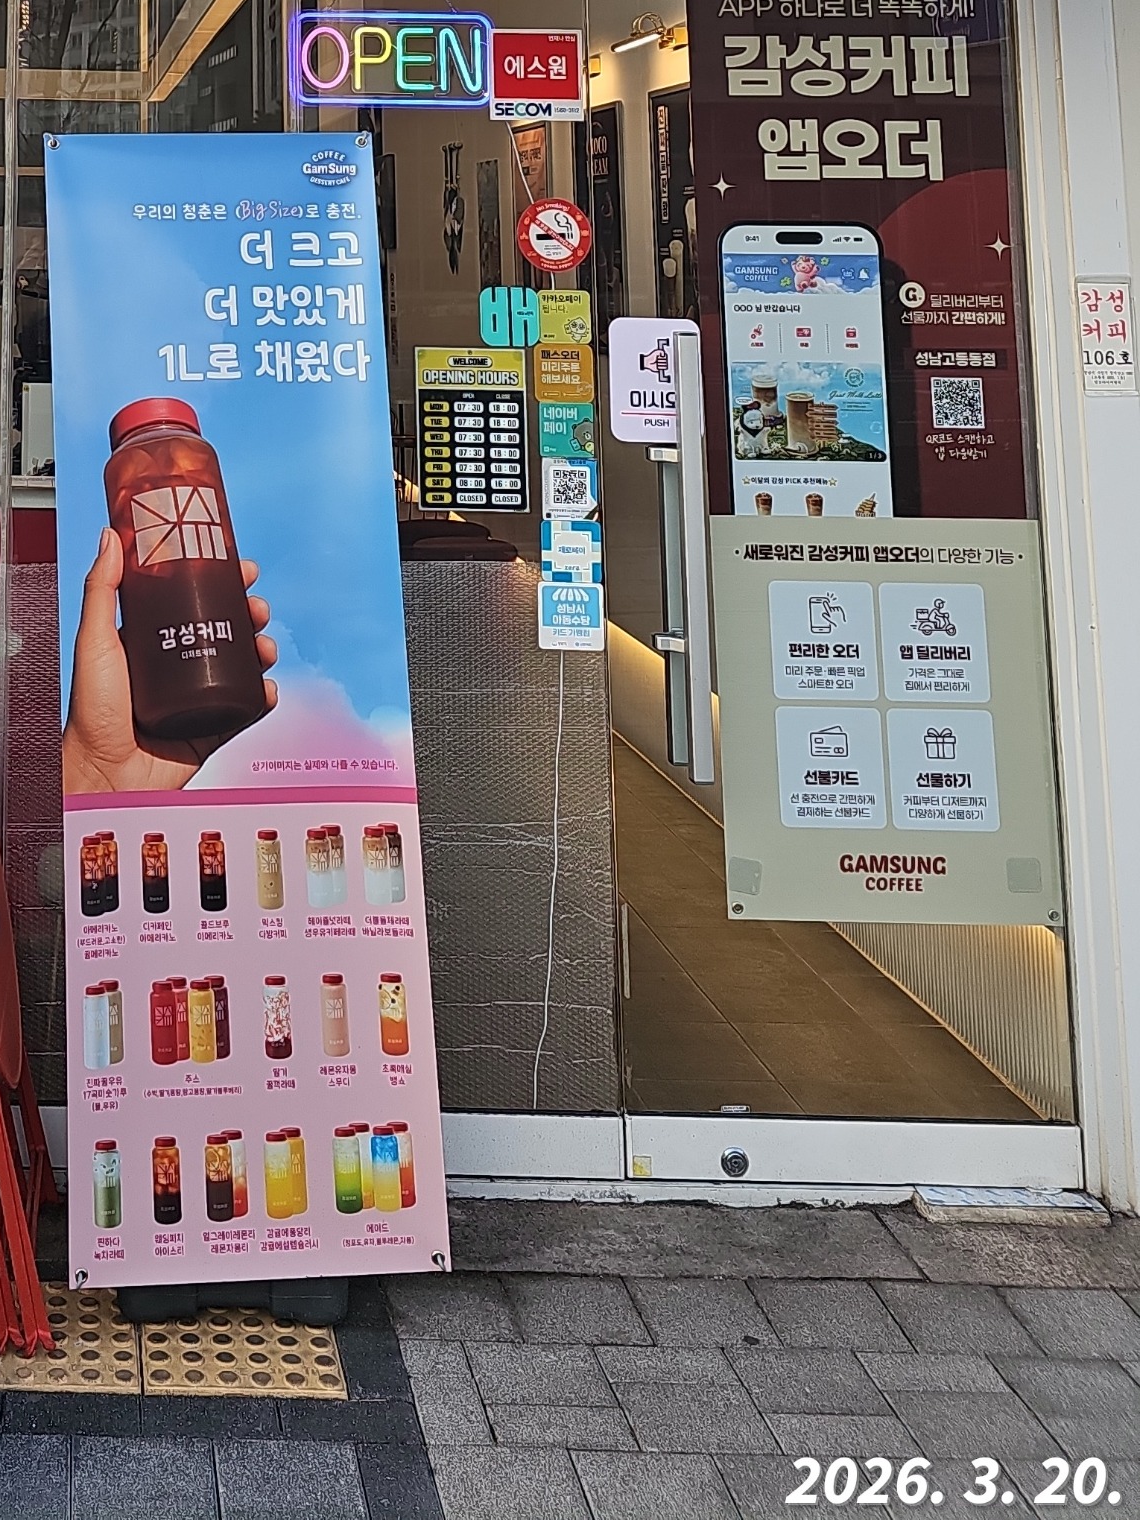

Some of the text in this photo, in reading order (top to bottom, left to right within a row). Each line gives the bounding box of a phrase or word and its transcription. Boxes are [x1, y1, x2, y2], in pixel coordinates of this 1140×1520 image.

[301, 25, 482, 92] OPEN
[503, 54, 568, 80] 에스원
[722, 33, 971, 98] 감성커피
[494, 101, 552, 117] SECOM
[311, 150, 346, 162] COFFEE
[757, 117, 945, 182] 앱오더
[302, 162, 357, 176] GamSung
[132, 202, 177, 221] 우리의
[182, 201, 228, 221] 청춘은
[326, 202, 362, 220] 충전.
[745, 235, 760, 243] 9:41
[239, 230, 364, 270] 더 크고
[734, 266, 779, 276] GAMSUNG
[204, 282, 367, 328] 더 맛있게
[541, 294, 581, 304] 카카오페이
[930, 294, 1004, 309] 딜리버리부터
[541, 304, 569, 314] 됩니다.
[763, 304, 801, 314] 반갑습니다
[900, 311, 1006, 326] 선물까지 간편하게!
[158, 338, 372, 384] 1L로 채웠다
[541, 349, 580, 360] 패스오더
[915, 351, 997, 368] 성남고등동점
[1082, 349, 1134, 366] 106호
[452, 357, 489, 366] WELCOME
[541, 362, 581, 373] 미리주문
[422, 369, 519, 386] OPENING HOURS
[541, 374, 581, 385] 해보세요
[543, 406, 578, 420] 네이버
[543, 421, 567, 435] 페이
[643, 418, 670, 428] PUSH
[925, 432, 995, 445] QR코드 스캔하고
[934, 446, 987, 461] 앱 다운받기
[785, 478, 802, 486] PICK
[459, 494, 484, 503] CLOSED
[494, 495, 519, 504] CLOSED
[743, 544, 1014, 566] 새로워진 감성커피 앱오더의 다양한 기능
[556, 603, 586, 615] 성남시
[159, 620, 234, 650] 감성커피
[181, 647, 217, 660] 디저트카페
[788, 643, 860, 660] 편리한 오더
[899, 645, 971, 661] 앱 딜리버리
[785, 665, 803, 676] 미리
[847, 666, 865, 678] 픽업
[908, 667, 965, 679] 가격은 그대로
[798, 678, 854, 690] 스마트한 오더
[904, 680, 971, 693] 집에서 편리하게
[251, 759, 399, 772] 상기이미지는 실제와 다를 수 있습니다.
[803, 770, 860, 786] 선불카드
[916, 773, 972, 789] 선물하기
[790, 793, 876, 806] 선 충전으로 간편하게
[903, 795, 987, 808] 커피부터 디저트까지
[796, 806, 871, 819] 결제하는 선불카드
[908, 808, 984, 821] 다양하게 선물하기
[839, 853, 947, 876] GAMSUNG
[864, 876, 924, 893] COFFEE
[142, 921, 172, 931] 디카페인
[258, 928, 288, 939] 다방커피
[185, 1073, 200, 1083] 주스
[328, 1077, 351, 1088] 스무디
[365, 1222, 390, 1234] 에이드
